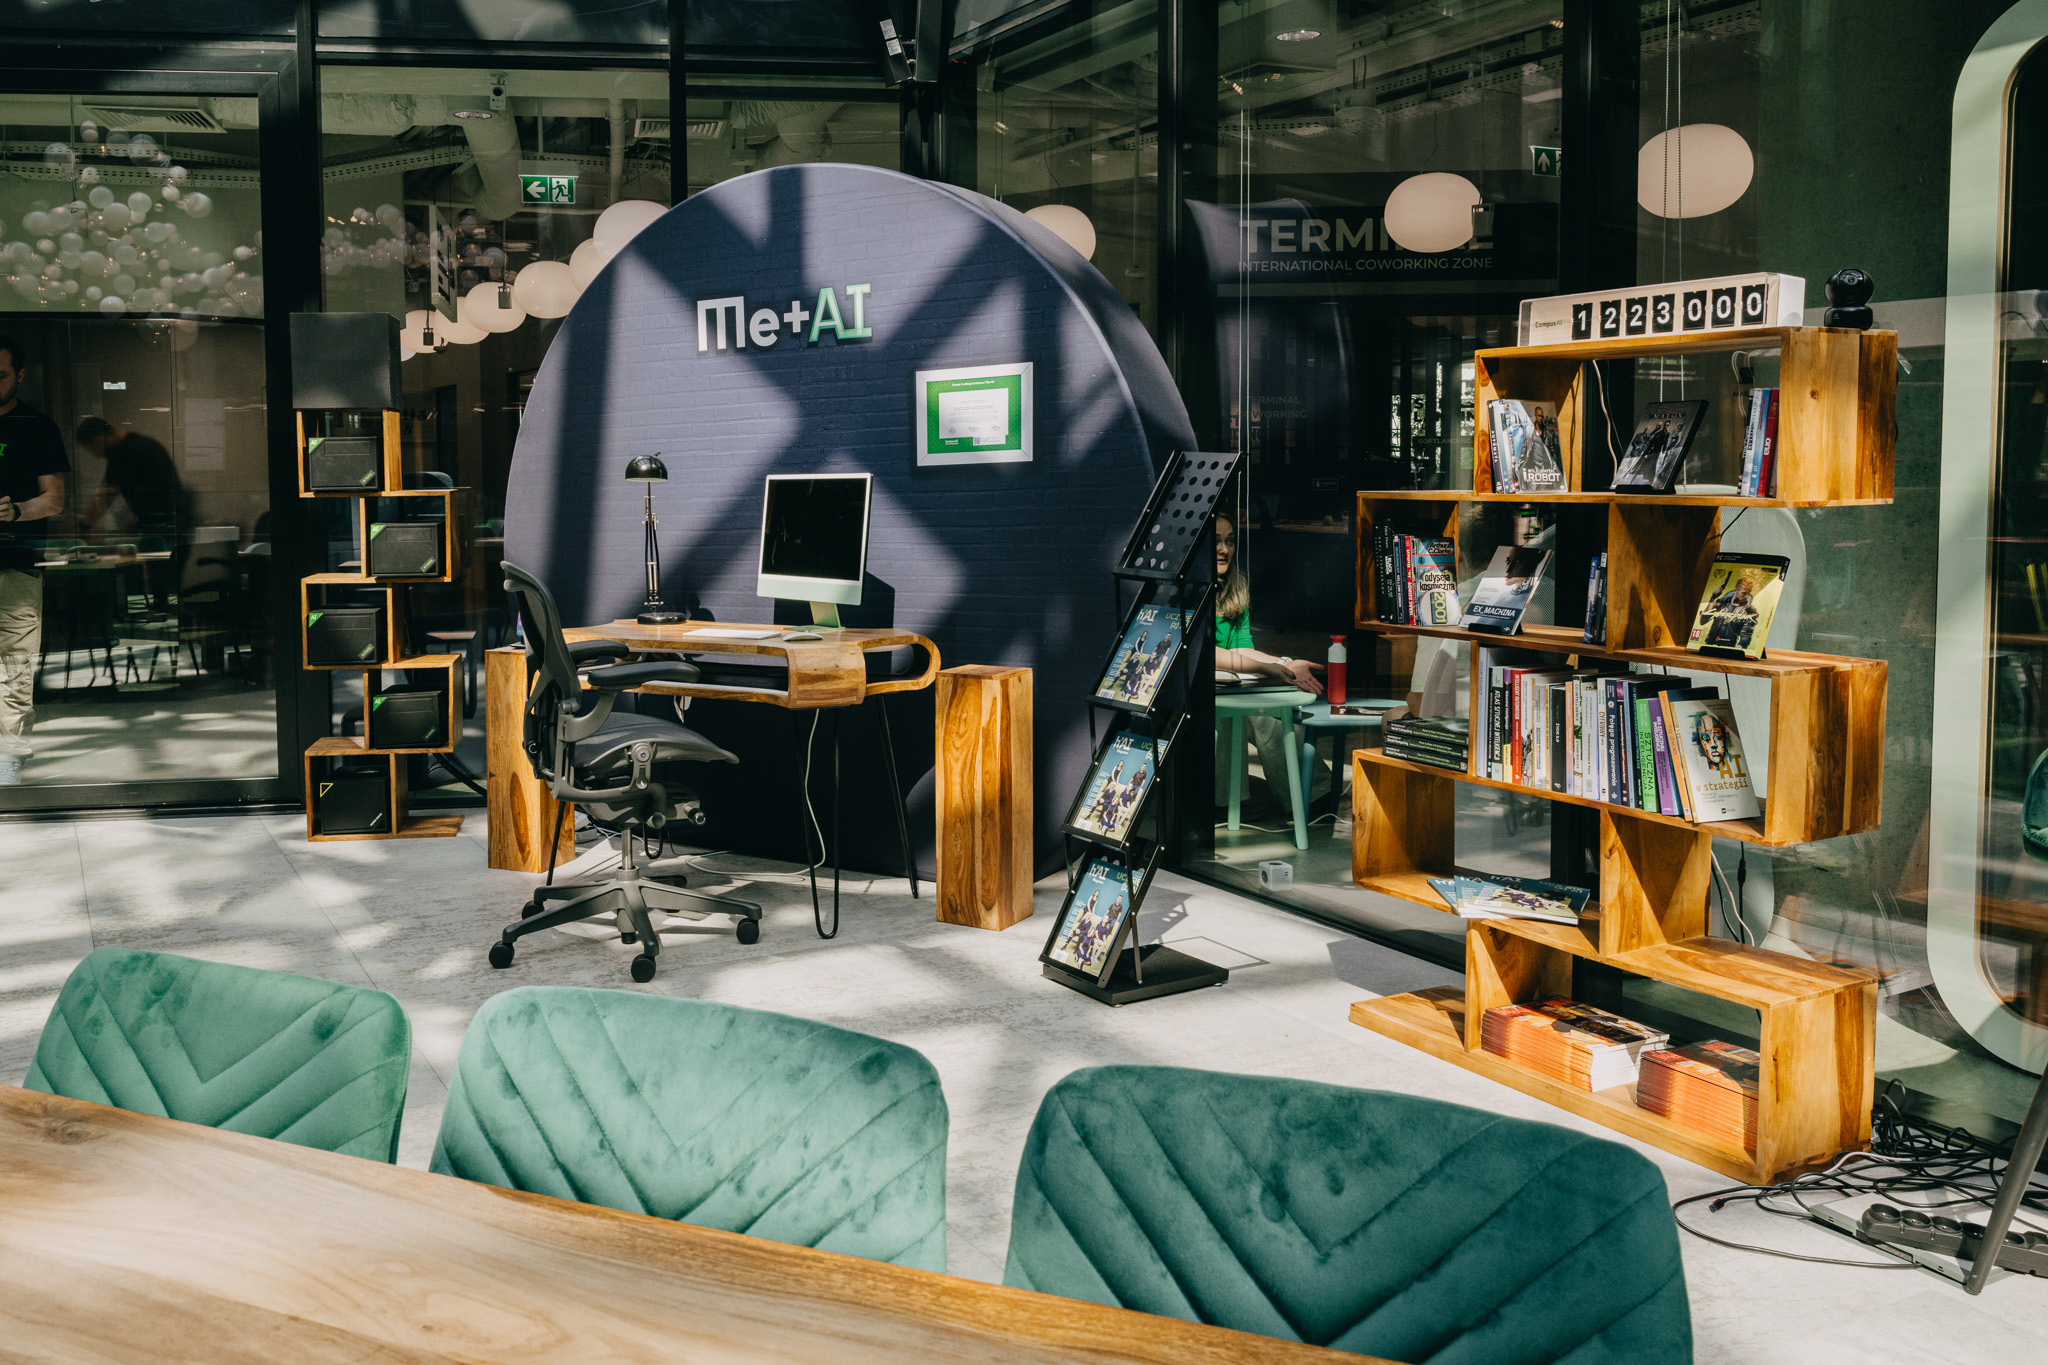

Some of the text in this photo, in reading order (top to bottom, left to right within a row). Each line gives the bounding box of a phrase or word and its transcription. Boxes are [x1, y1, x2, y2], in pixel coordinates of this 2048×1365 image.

[1239, 217, 1494, 254] TERMI
[1239, 256, 1494, 273] INTERNATIONAL COWORKING ZONE
[1420, 581, 1456, 591] kosmiczna
[1424, 573, 1451, 584] odyseja
[1434, 592, 1447, 623] 2001
[1691, 630, 1701, 639] 18
[1493, 706, 1501, 731] SZTUCZNEJ
[1493, 731, 1501, 761] INTELIGENCJI
[1609, 738, 1618, 787] prognozowania
[1640, 732, 1648, 790] INTELIGENCJA
[1644, 732, 1654, 791] SZTUCZNA
[1716, 754, 1747, 780] AI
[1696, 778, 1749, 793] w strategii
